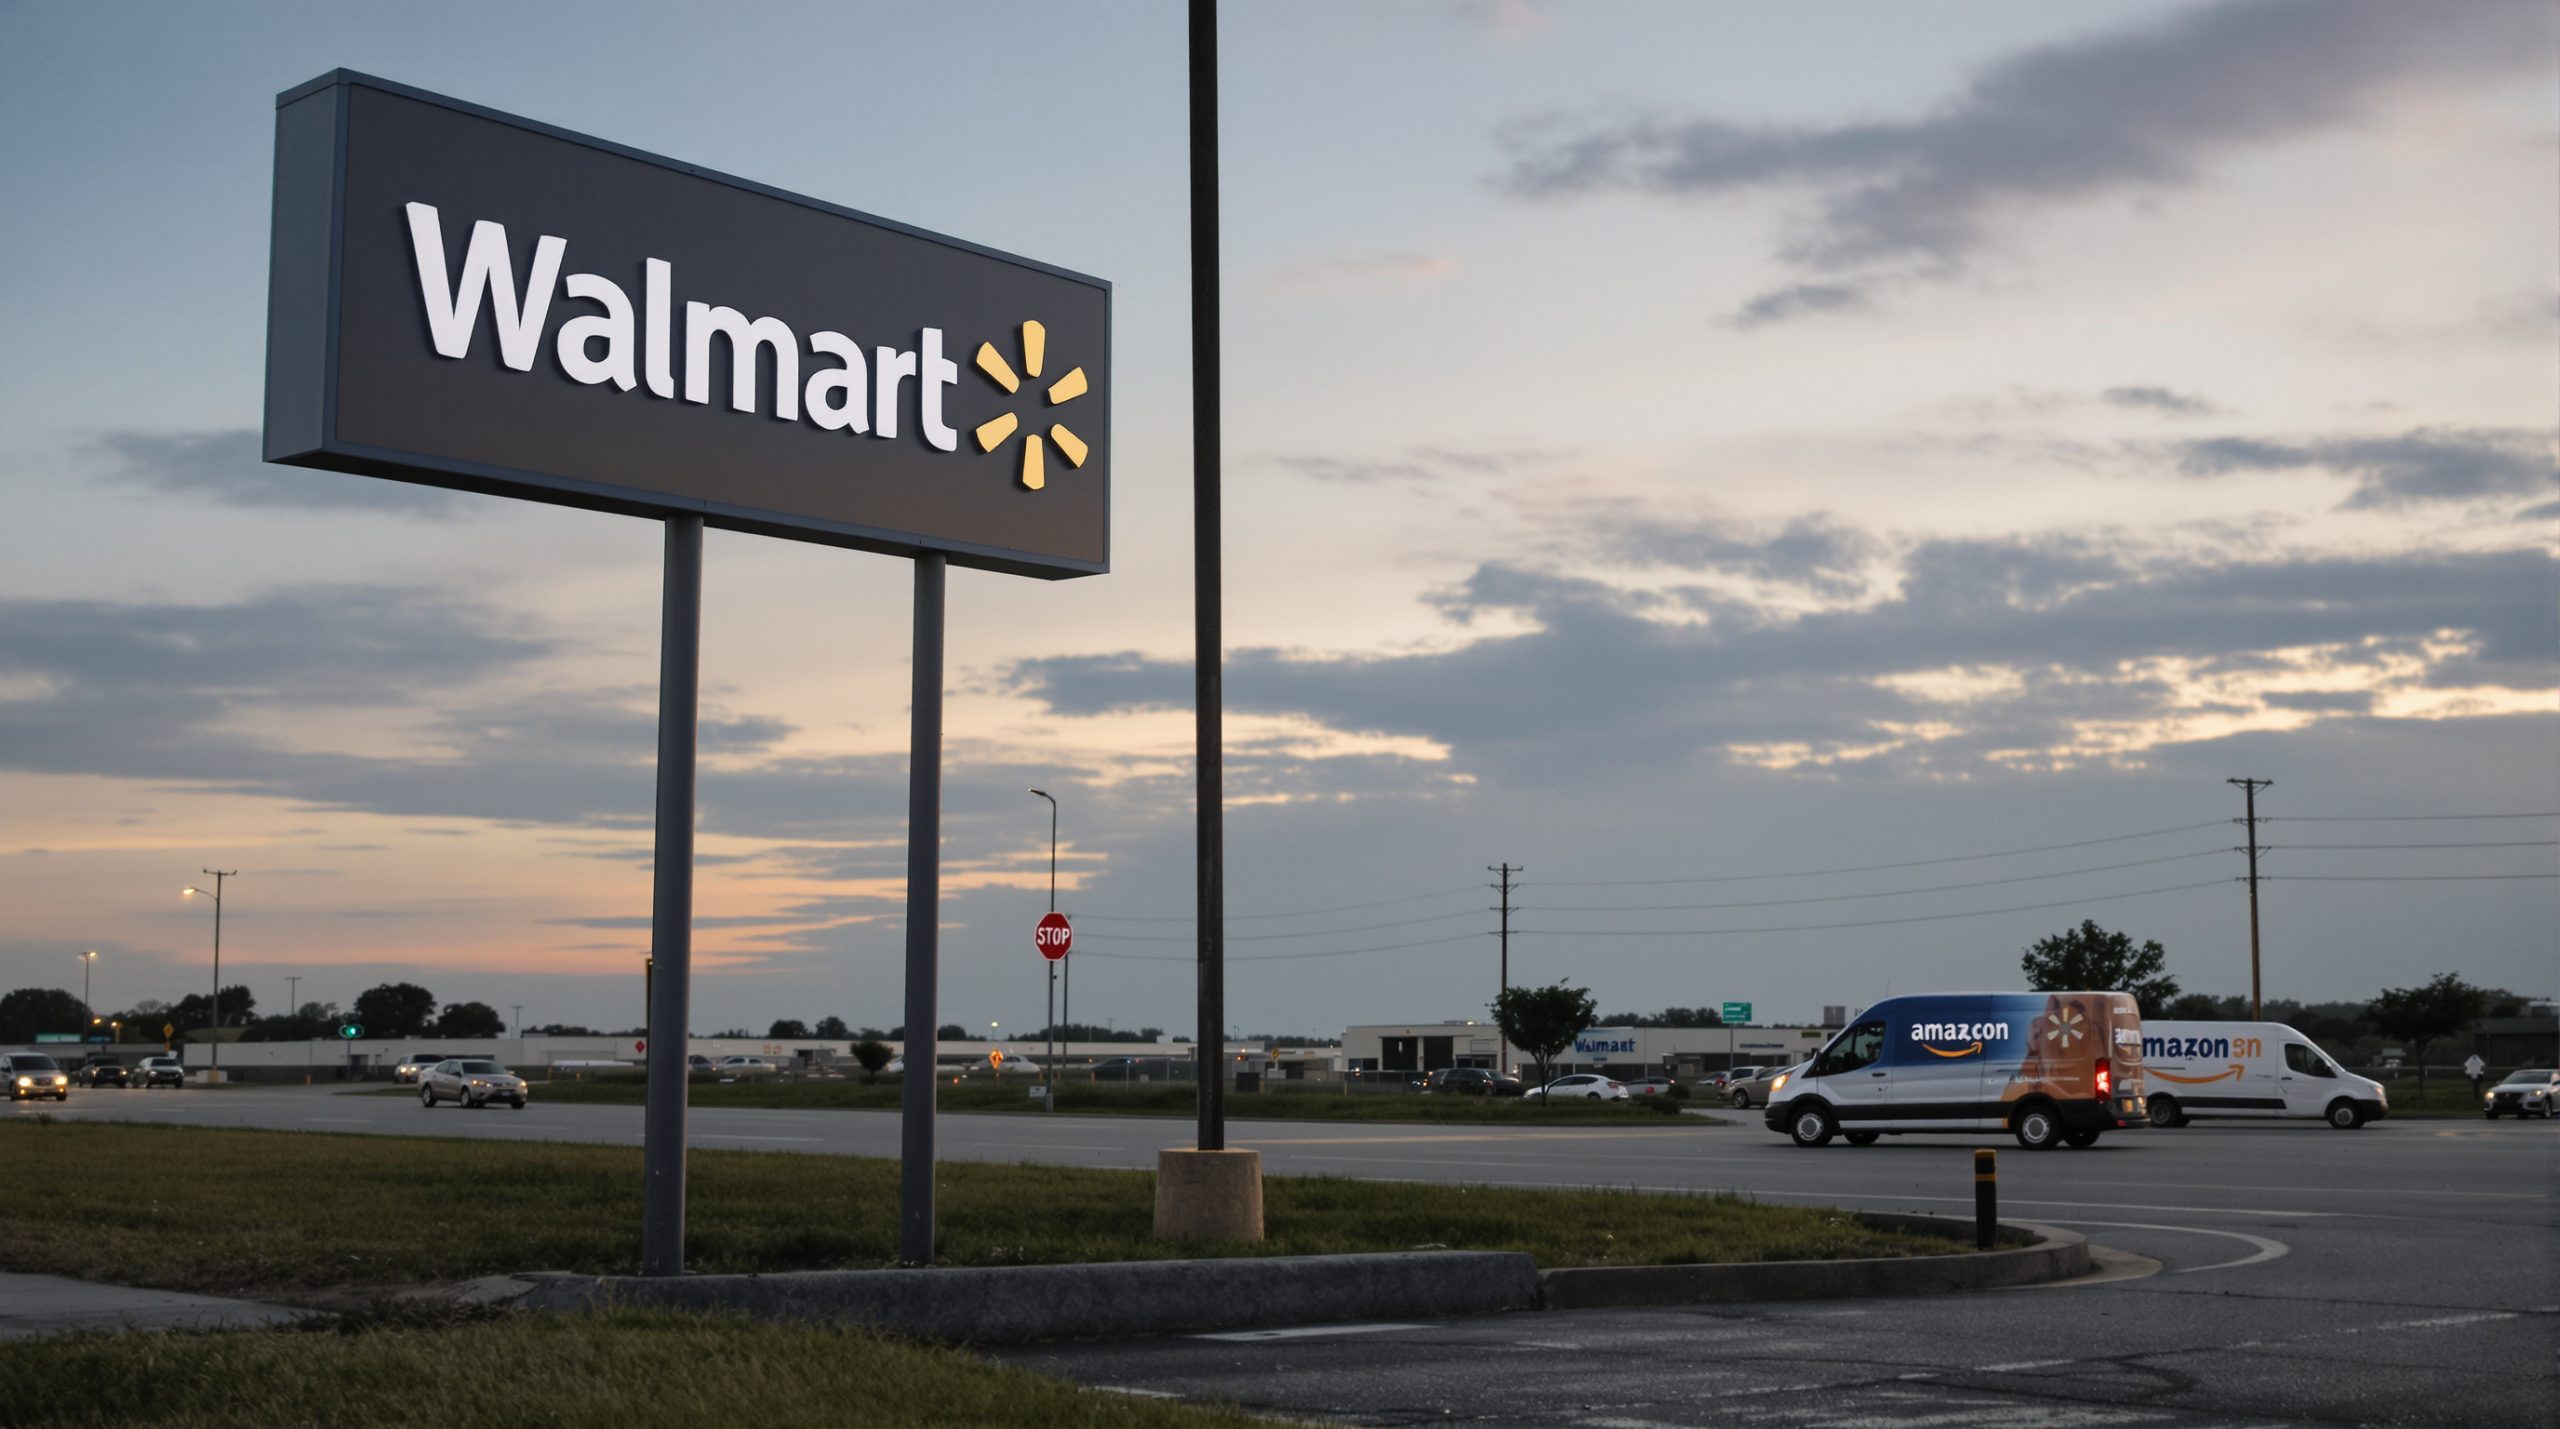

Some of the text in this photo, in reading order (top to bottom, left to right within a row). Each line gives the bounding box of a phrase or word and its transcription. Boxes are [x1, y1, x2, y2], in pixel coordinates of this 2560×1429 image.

[405, 201, 958, 452] Walmart
[1037, 927, 1070, 945] STOP
[2142, 1037, 2229, 1059] mazon
